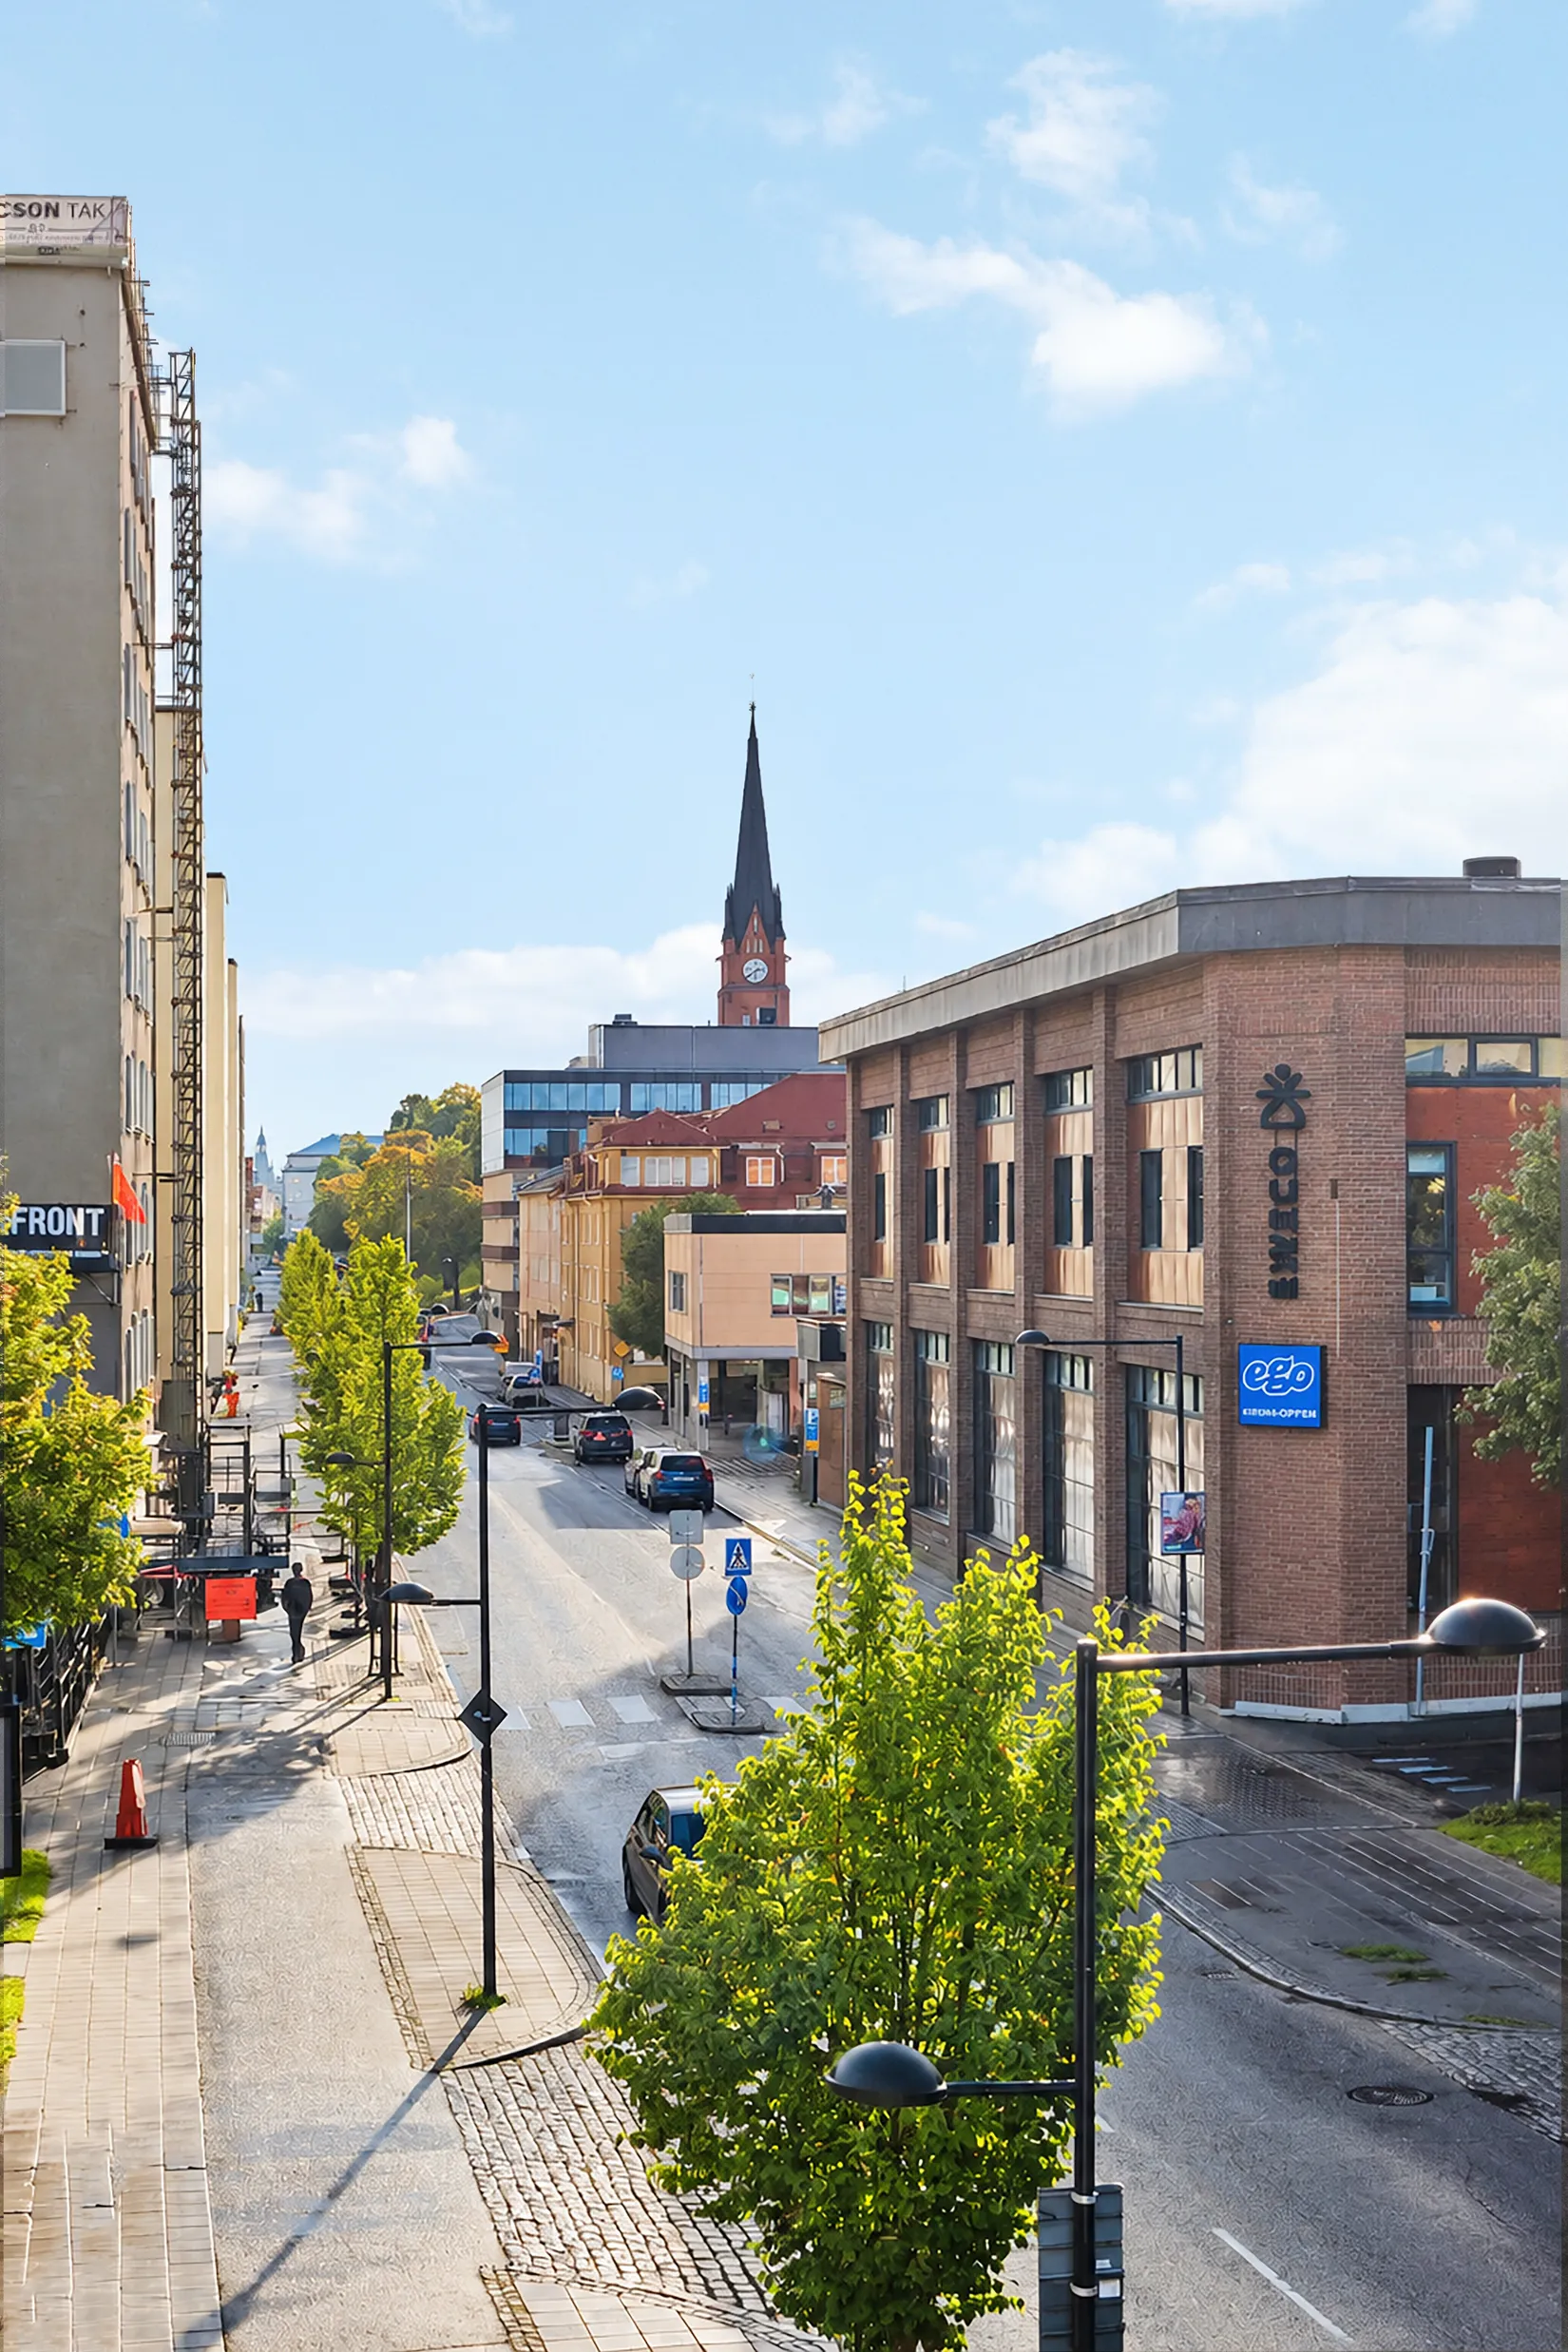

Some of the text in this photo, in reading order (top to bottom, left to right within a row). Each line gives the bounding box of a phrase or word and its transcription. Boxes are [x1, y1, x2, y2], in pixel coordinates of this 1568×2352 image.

[67, 202, 105, 219] TAK
[10, 1206, 105, 1235] FRONT
[1243, 1355, 1314, 1396] ego
